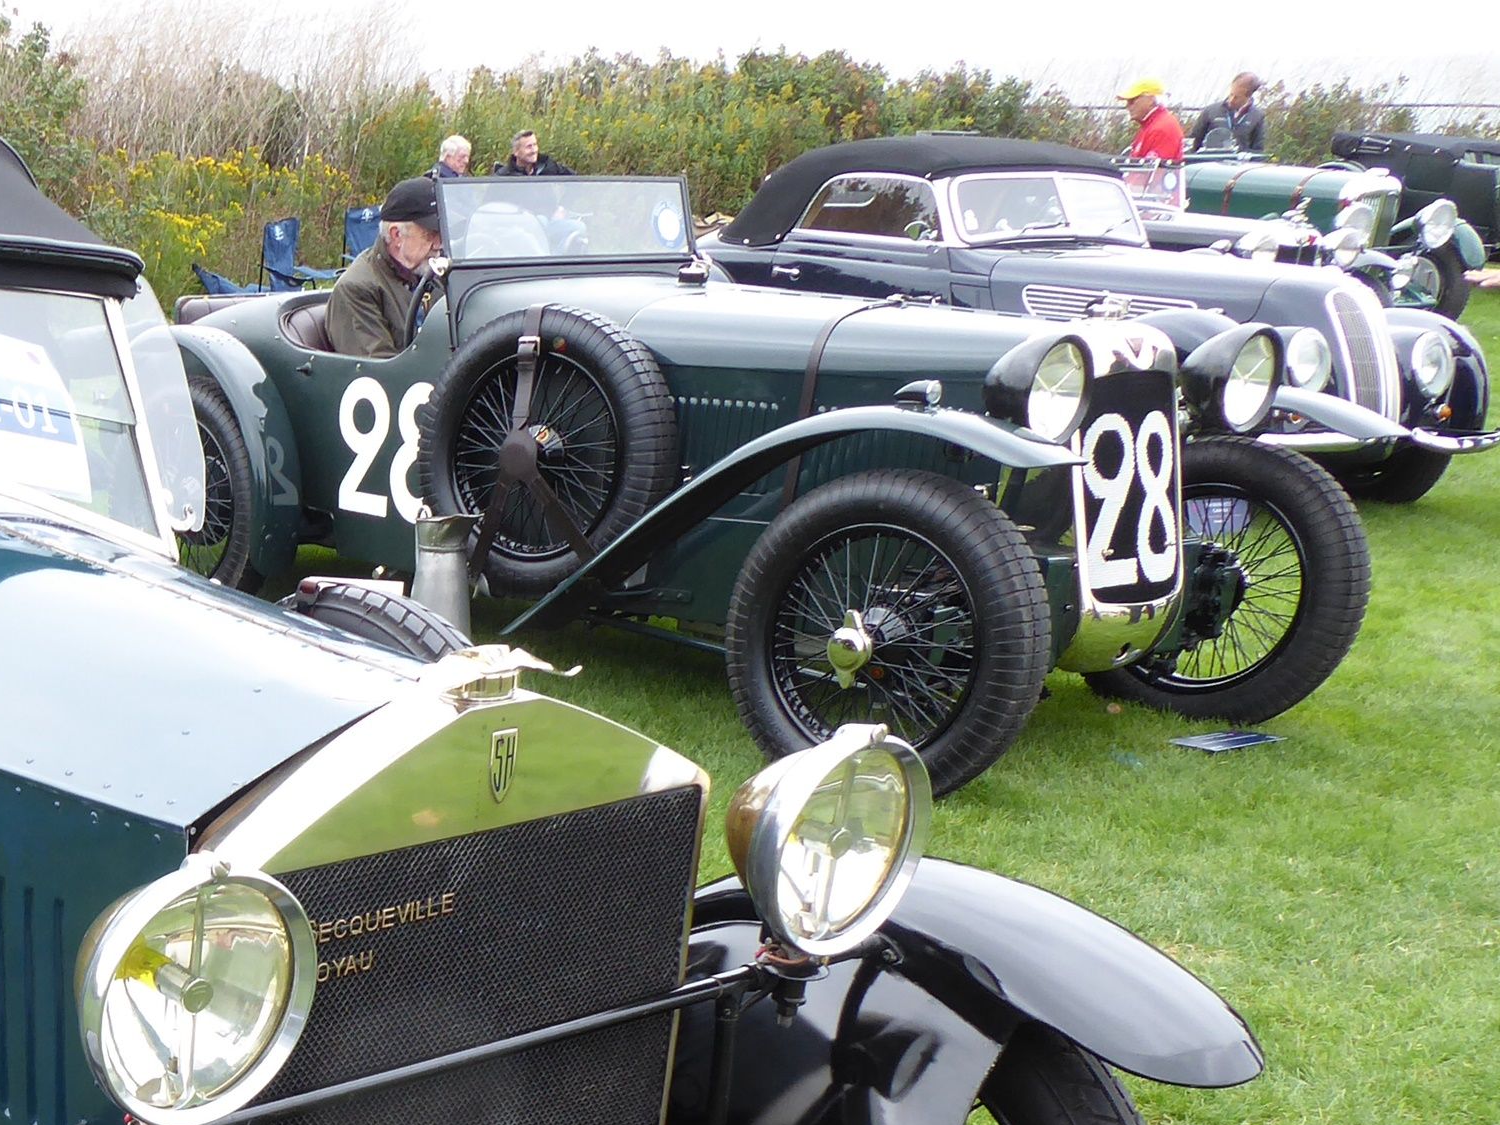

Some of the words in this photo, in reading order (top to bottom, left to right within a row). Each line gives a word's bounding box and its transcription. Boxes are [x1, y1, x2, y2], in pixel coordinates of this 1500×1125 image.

[1082, 410, 1177, 589] 28
[494, 735, 516, 793] SH
[316, 949, 373, 982] OYAU
